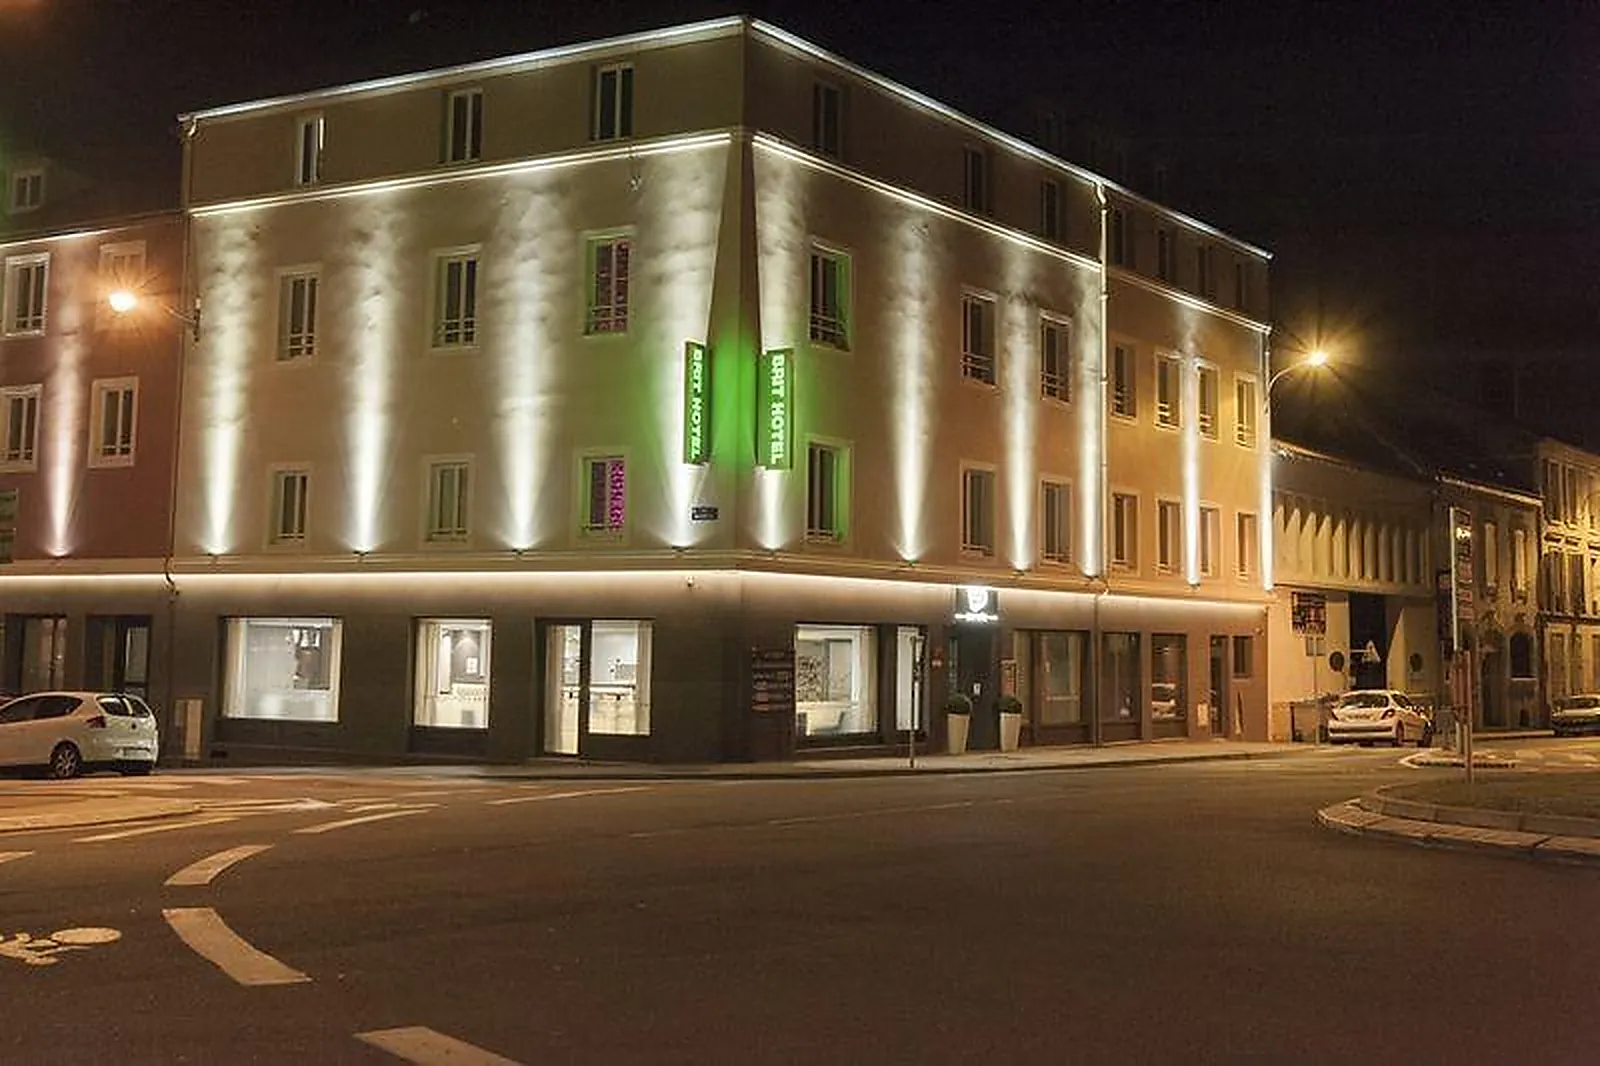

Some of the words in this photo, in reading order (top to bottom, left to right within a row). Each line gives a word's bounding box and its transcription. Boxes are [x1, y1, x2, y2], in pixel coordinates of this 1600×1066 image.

[771, 354, 785, 397] BRIT
[690, 397, 702, 460] HOTEL
[771, 402, 785, 464] HOTEL
